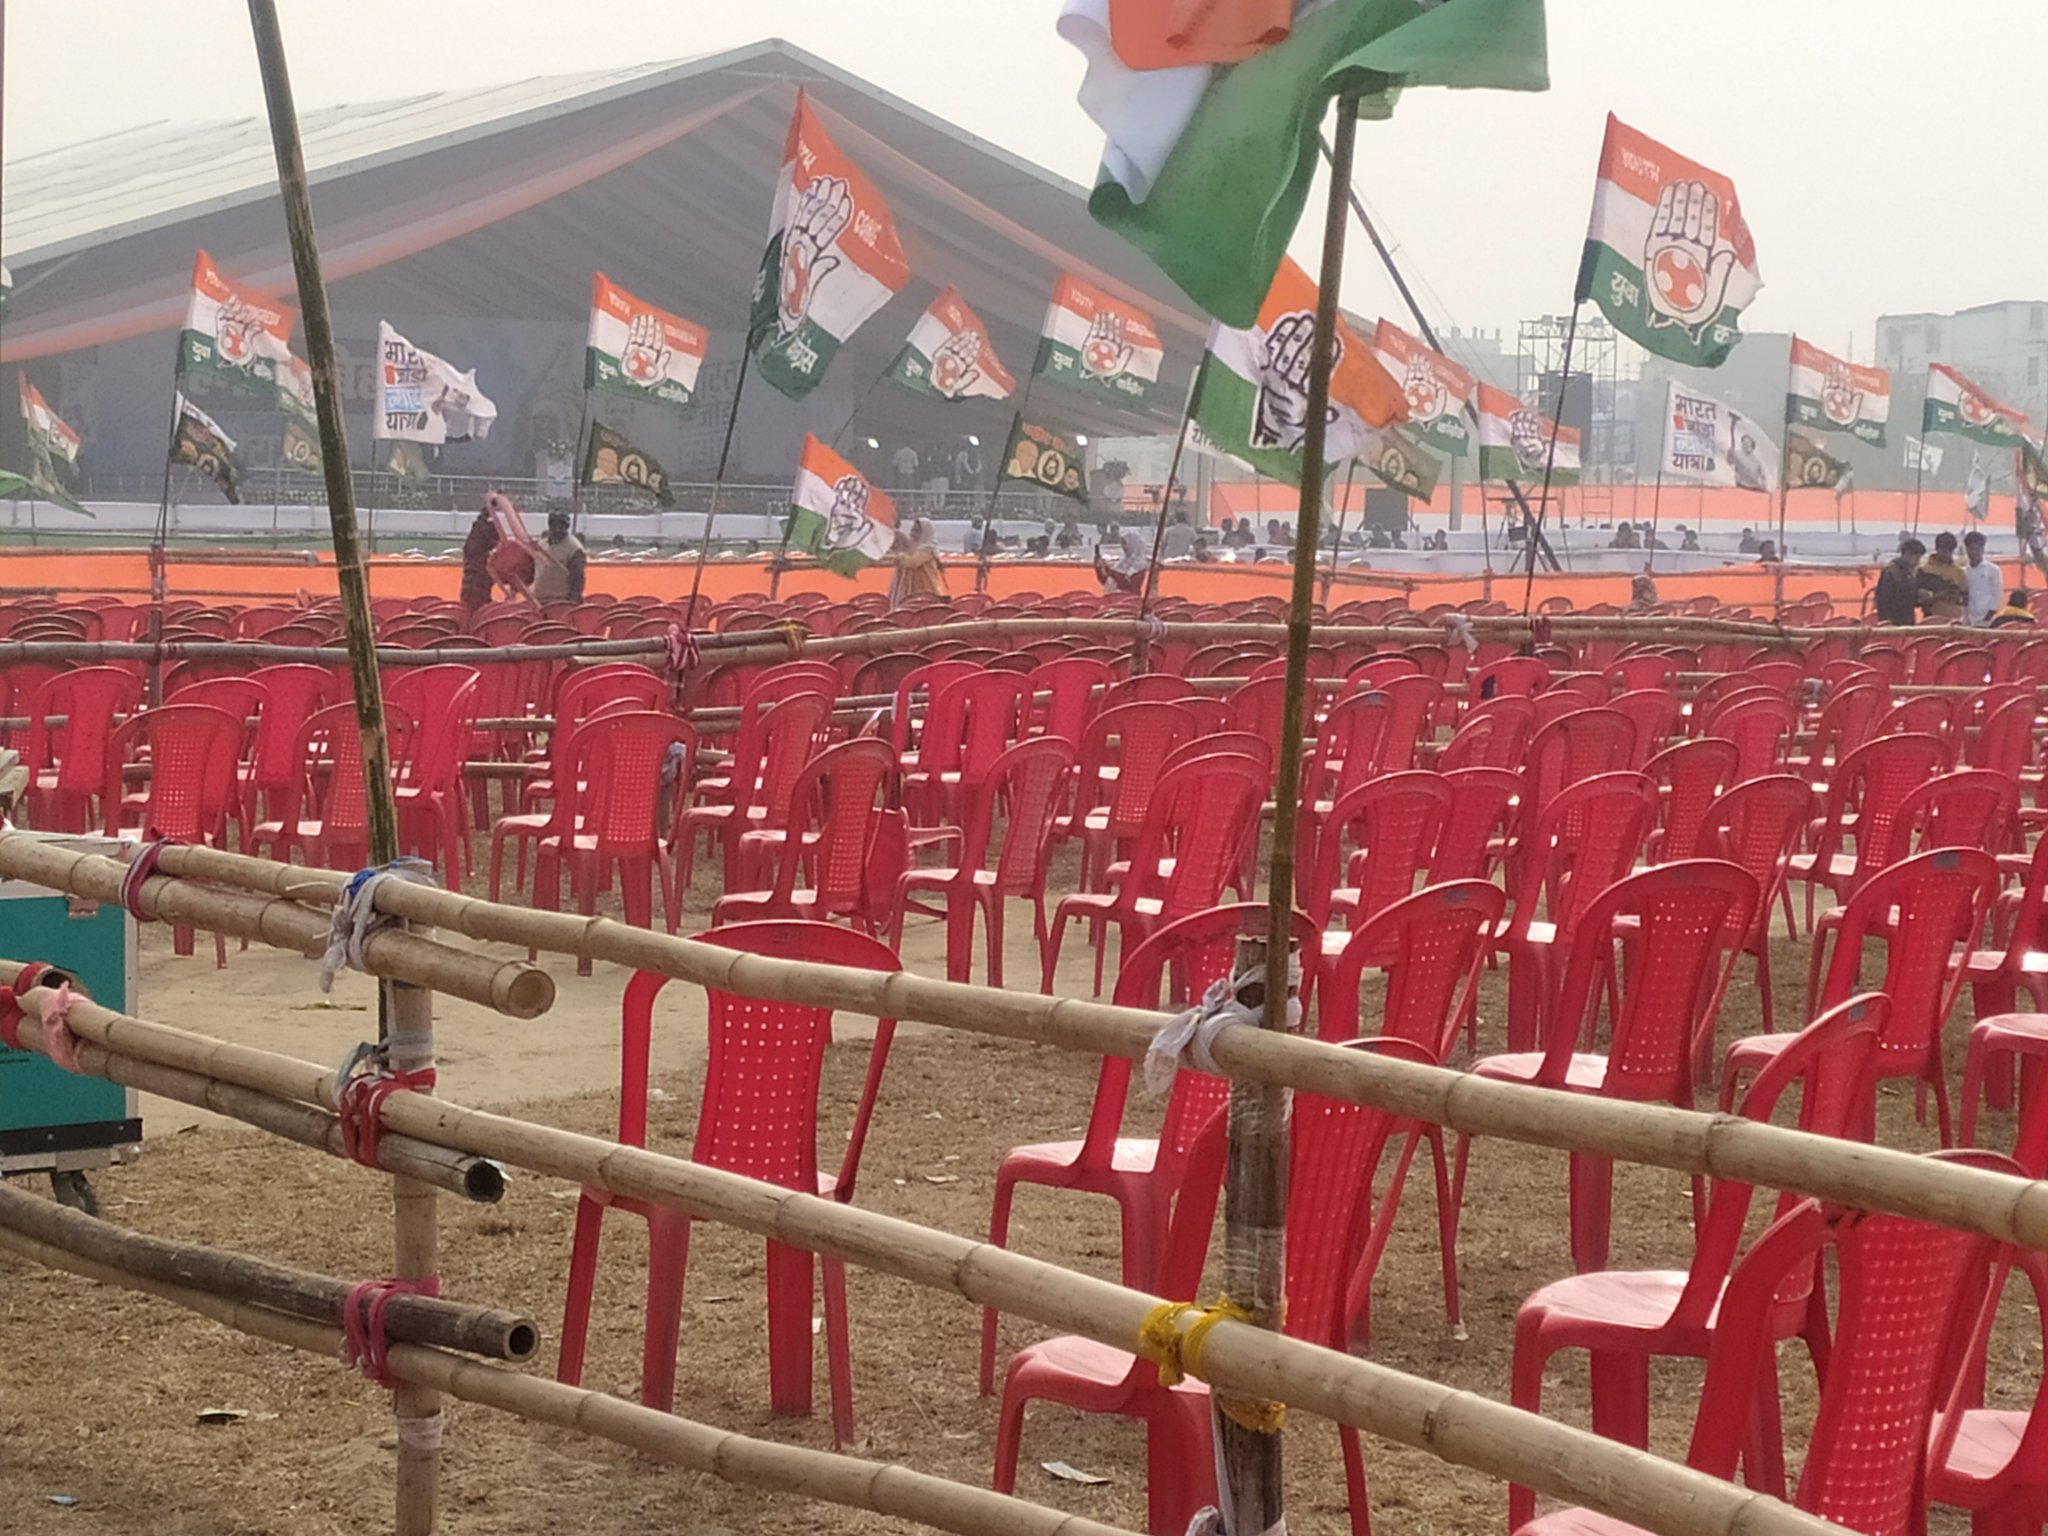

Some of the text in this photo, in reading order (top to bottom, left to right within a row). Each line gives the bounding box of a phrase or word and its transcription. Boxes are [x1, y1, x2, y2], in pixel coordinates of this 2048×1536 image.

[1611, 270, 1641, 307] युवा
[1674, 393, 1718, 421] भारत
[1671, 452, 1707, 471] यात्रा
